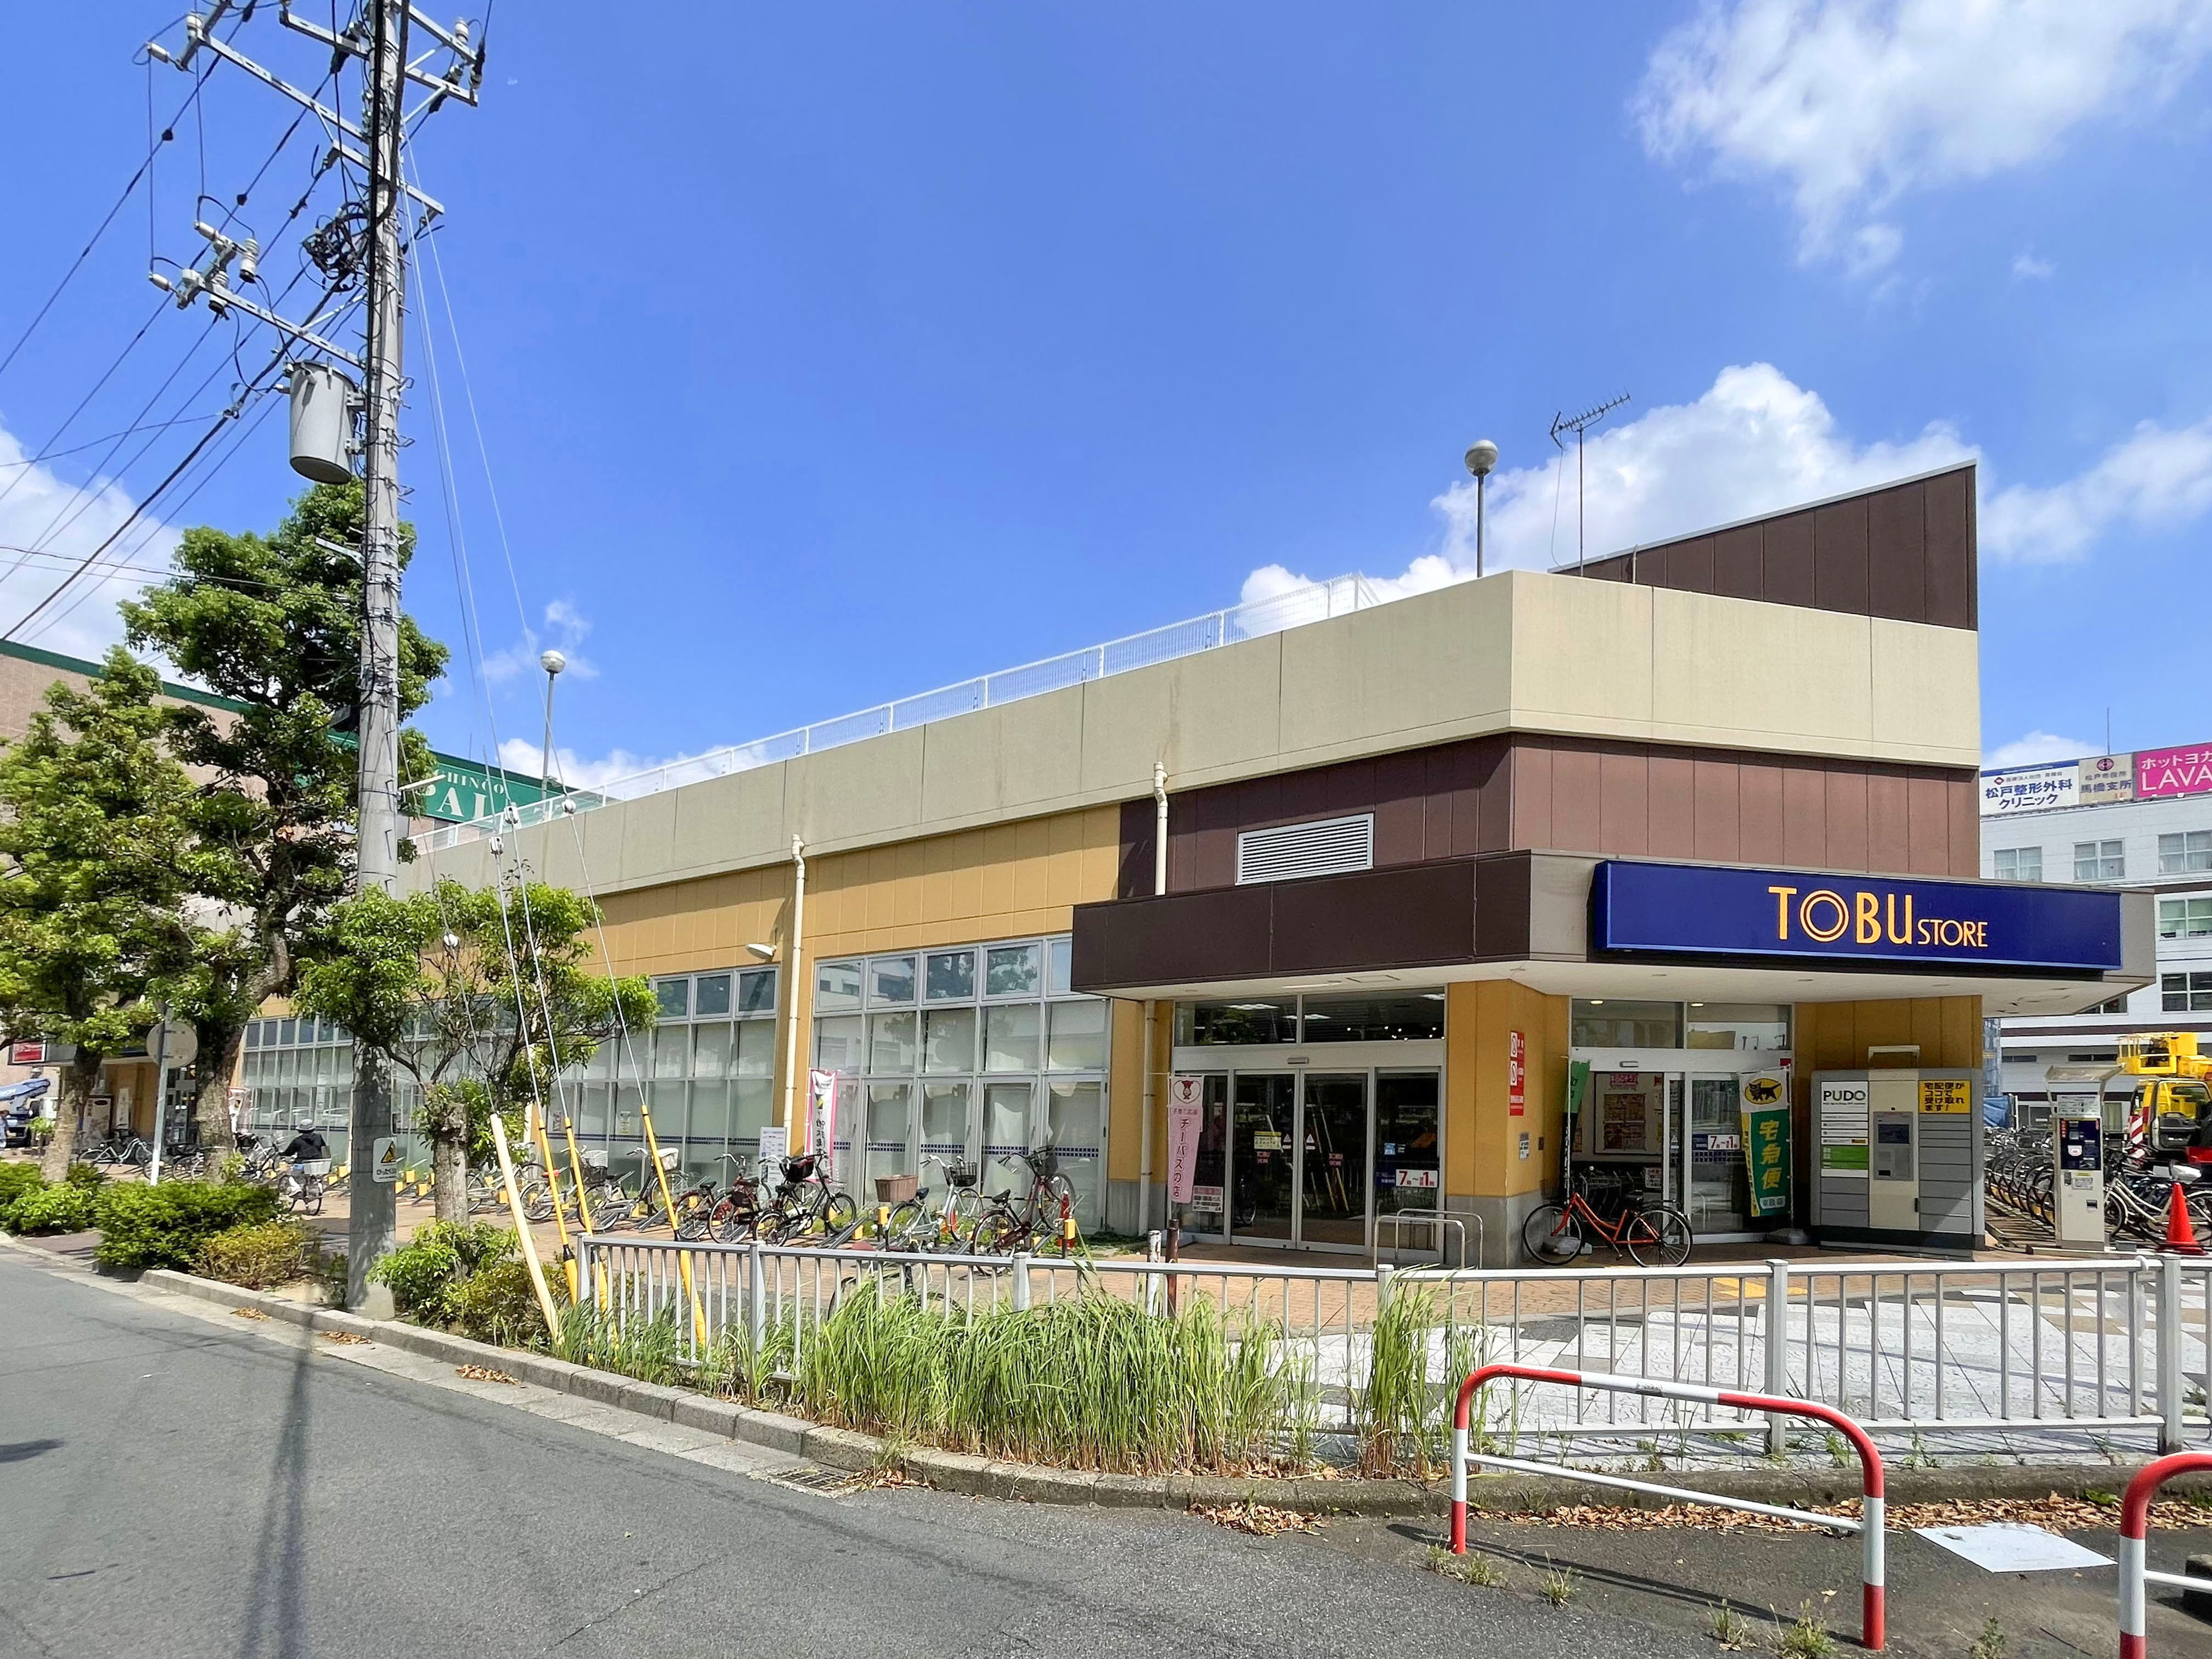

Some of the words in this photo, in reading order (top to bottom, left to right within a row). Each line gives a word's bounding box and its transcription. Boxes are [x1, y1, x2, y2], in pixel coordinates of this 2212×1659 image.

[2081, 780, 2132, 793] 馬橋支所
[2142, 764, 2212, 791] LAVA
[1985, 778, 2073, 799] 松戸整形外科
[1999, 793, 2058, 809] クリニック
[1768, 886, 1912, 945] TOBU
[1917, 919, 1988, 947] STORE
[1823, 1090, 1866, 1102] PUDO
[1759, 1120, 1782, 1190] 宅急便
